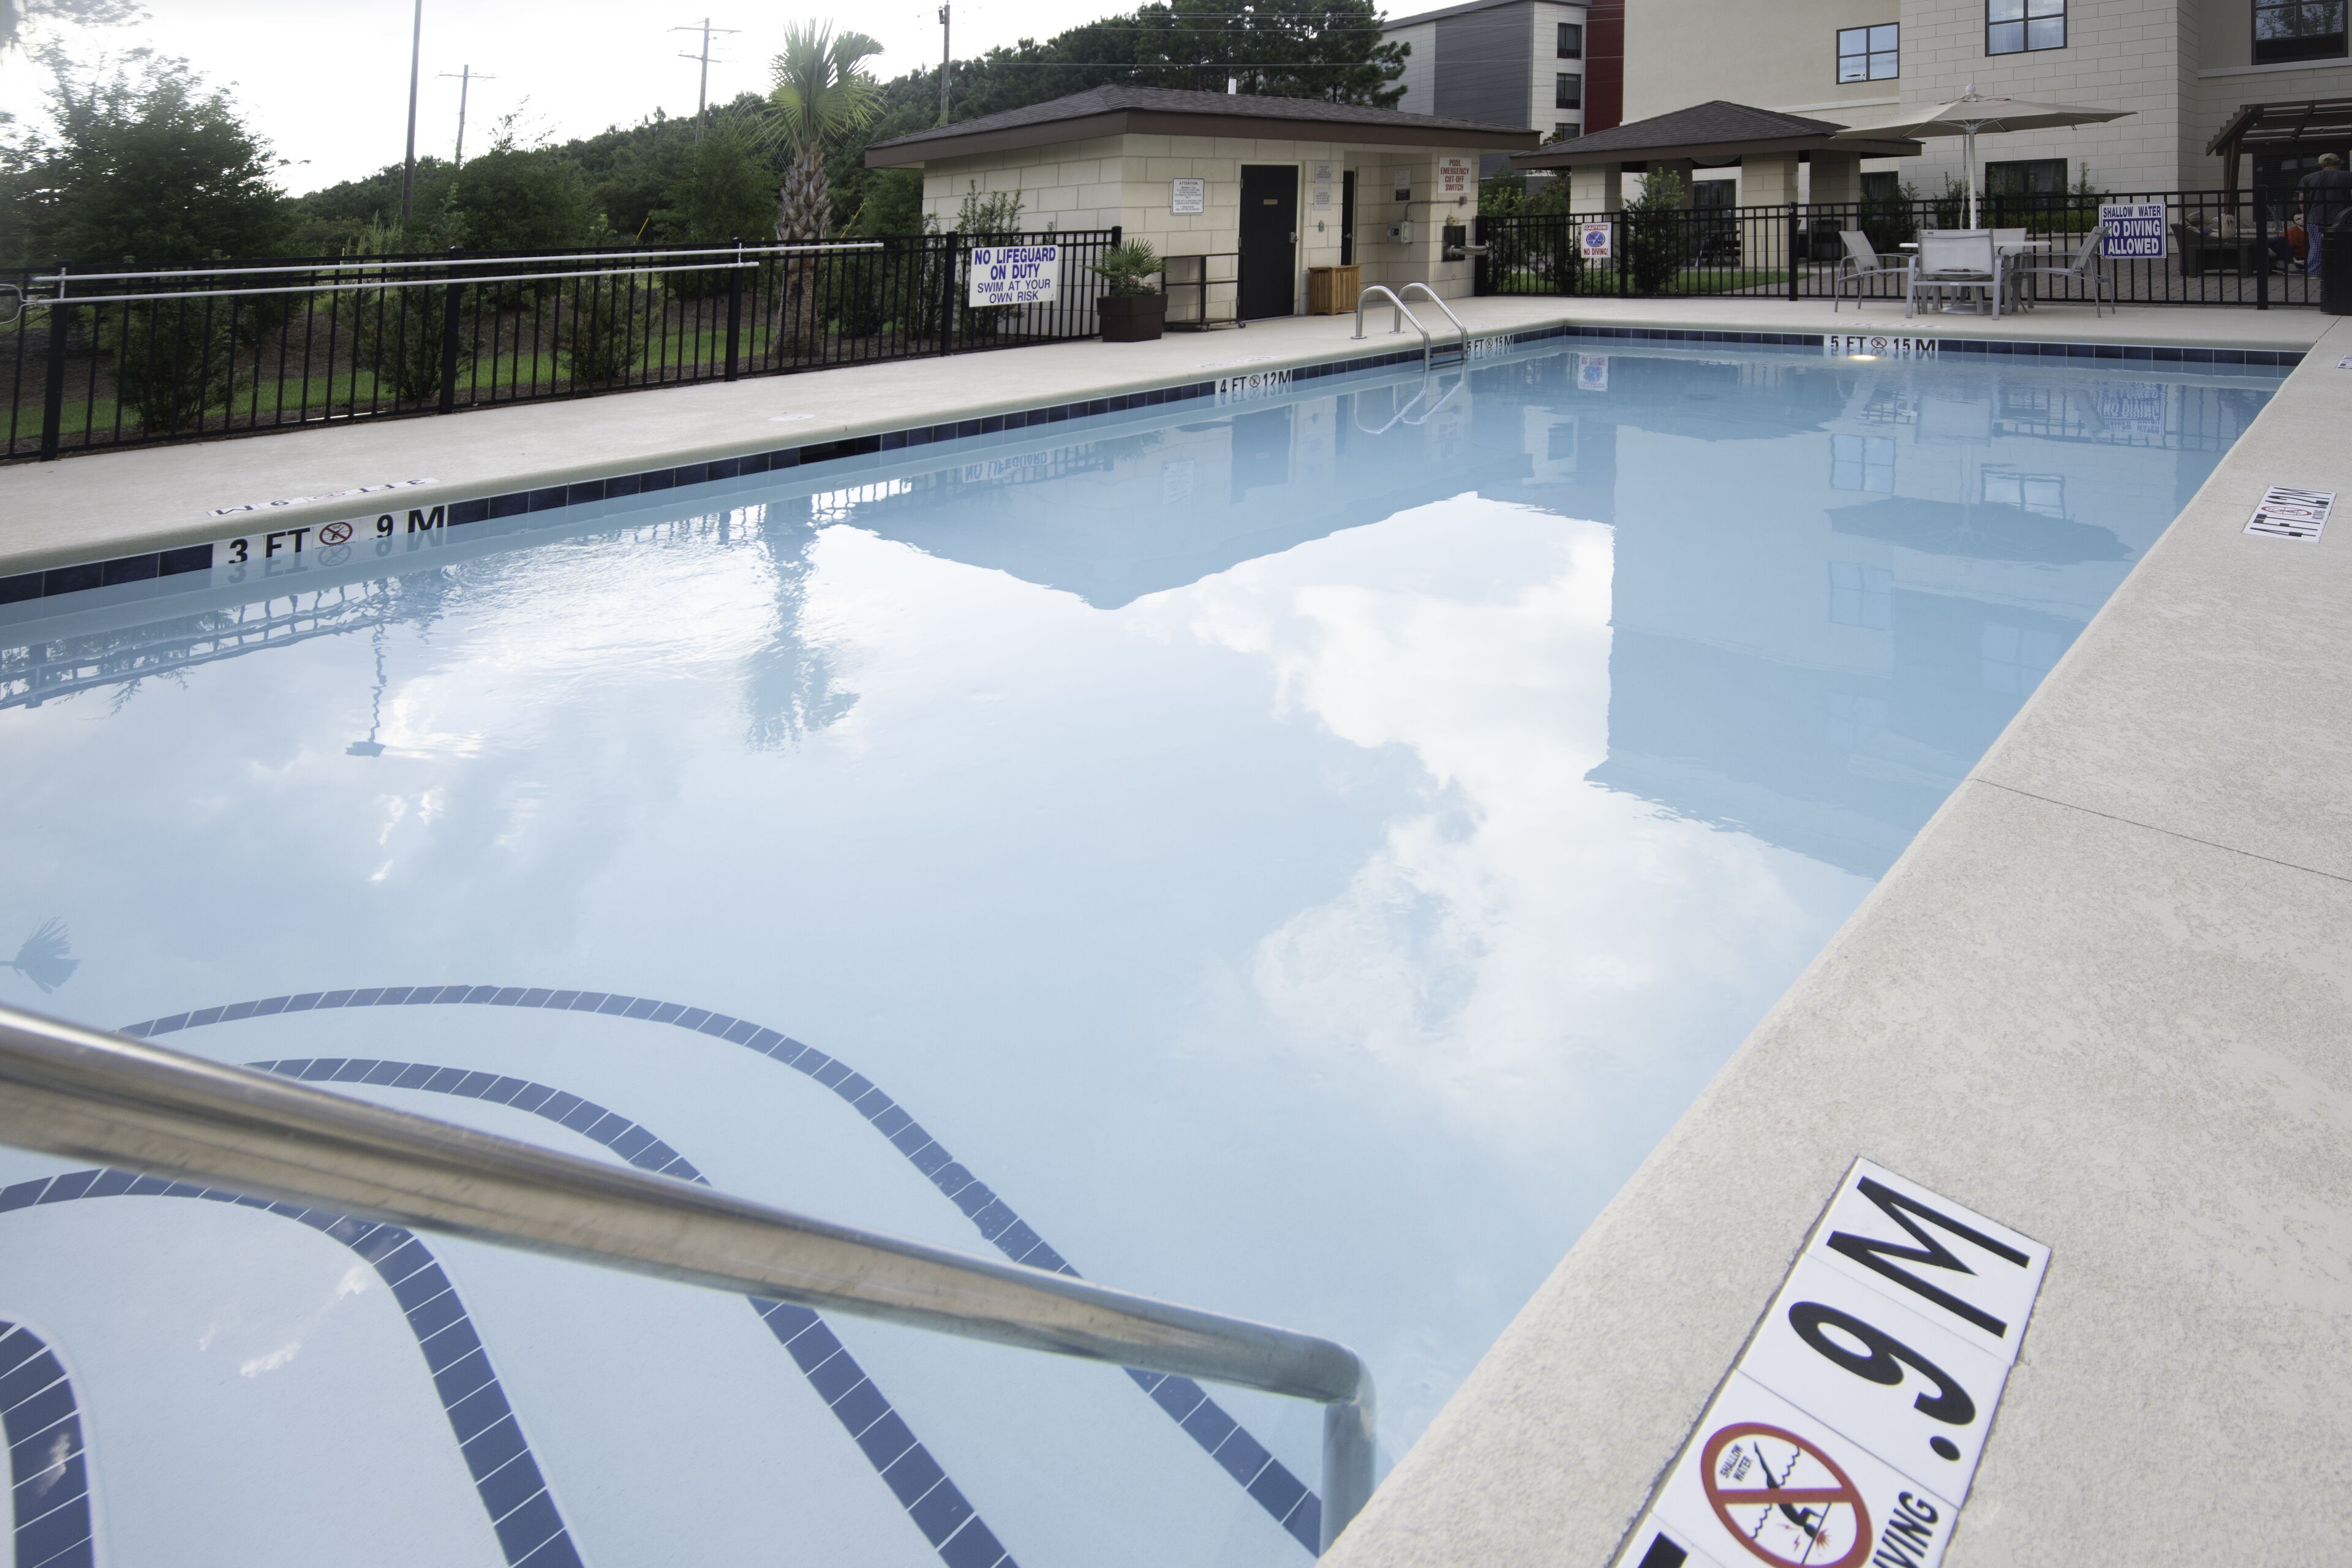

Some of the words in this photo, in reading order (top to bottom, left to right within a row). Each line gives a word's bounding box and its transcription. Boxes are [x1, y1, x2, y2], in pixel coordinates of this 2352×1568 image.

[2103, 206, 2133, 218] SHALLOW
[2138, 205, 2161, 217] WATER
[2124, 219, 2161, 237] DIVING
[2108, 238, 2159, 254] ALLOWED
[974, 249, 991, 265] NO
[996, 247, 1057, 263] LIFEGUARD
[990, 265, 1006, 281] ON
[1012, 263, 1040, 279] DUTY
[977, 282, 1003, 293] SWIM
[1008, 281, 1020, 290] AT
[1026, 279, 1051, 290] YOUR
[989, 293, 1012, 304] OWN
[1017, 290, 1039, 301] RISK
[1475, 339, 1484, 350] FT
[1504, 334, 1513, 345] M
[1831, 336, 1839, 347] 5
[1847, 336, 1867, 348] FT
[1916, 339, 1936, 350] M
[1220, 379, 1227, 393] 4
[1232, 376, 1247, 391] FT
[1279, 369, 1291, 383] M
[228, 538, 248, 564] 3
[265, 527, 311, 558] FT
[407, 505, 445, 533] M
[1826, 1175, 2030, 1339] M
[1720, 1444, 1743, 1478] SHALLOW
[1733, 1456, 1752, 1482] WATER
